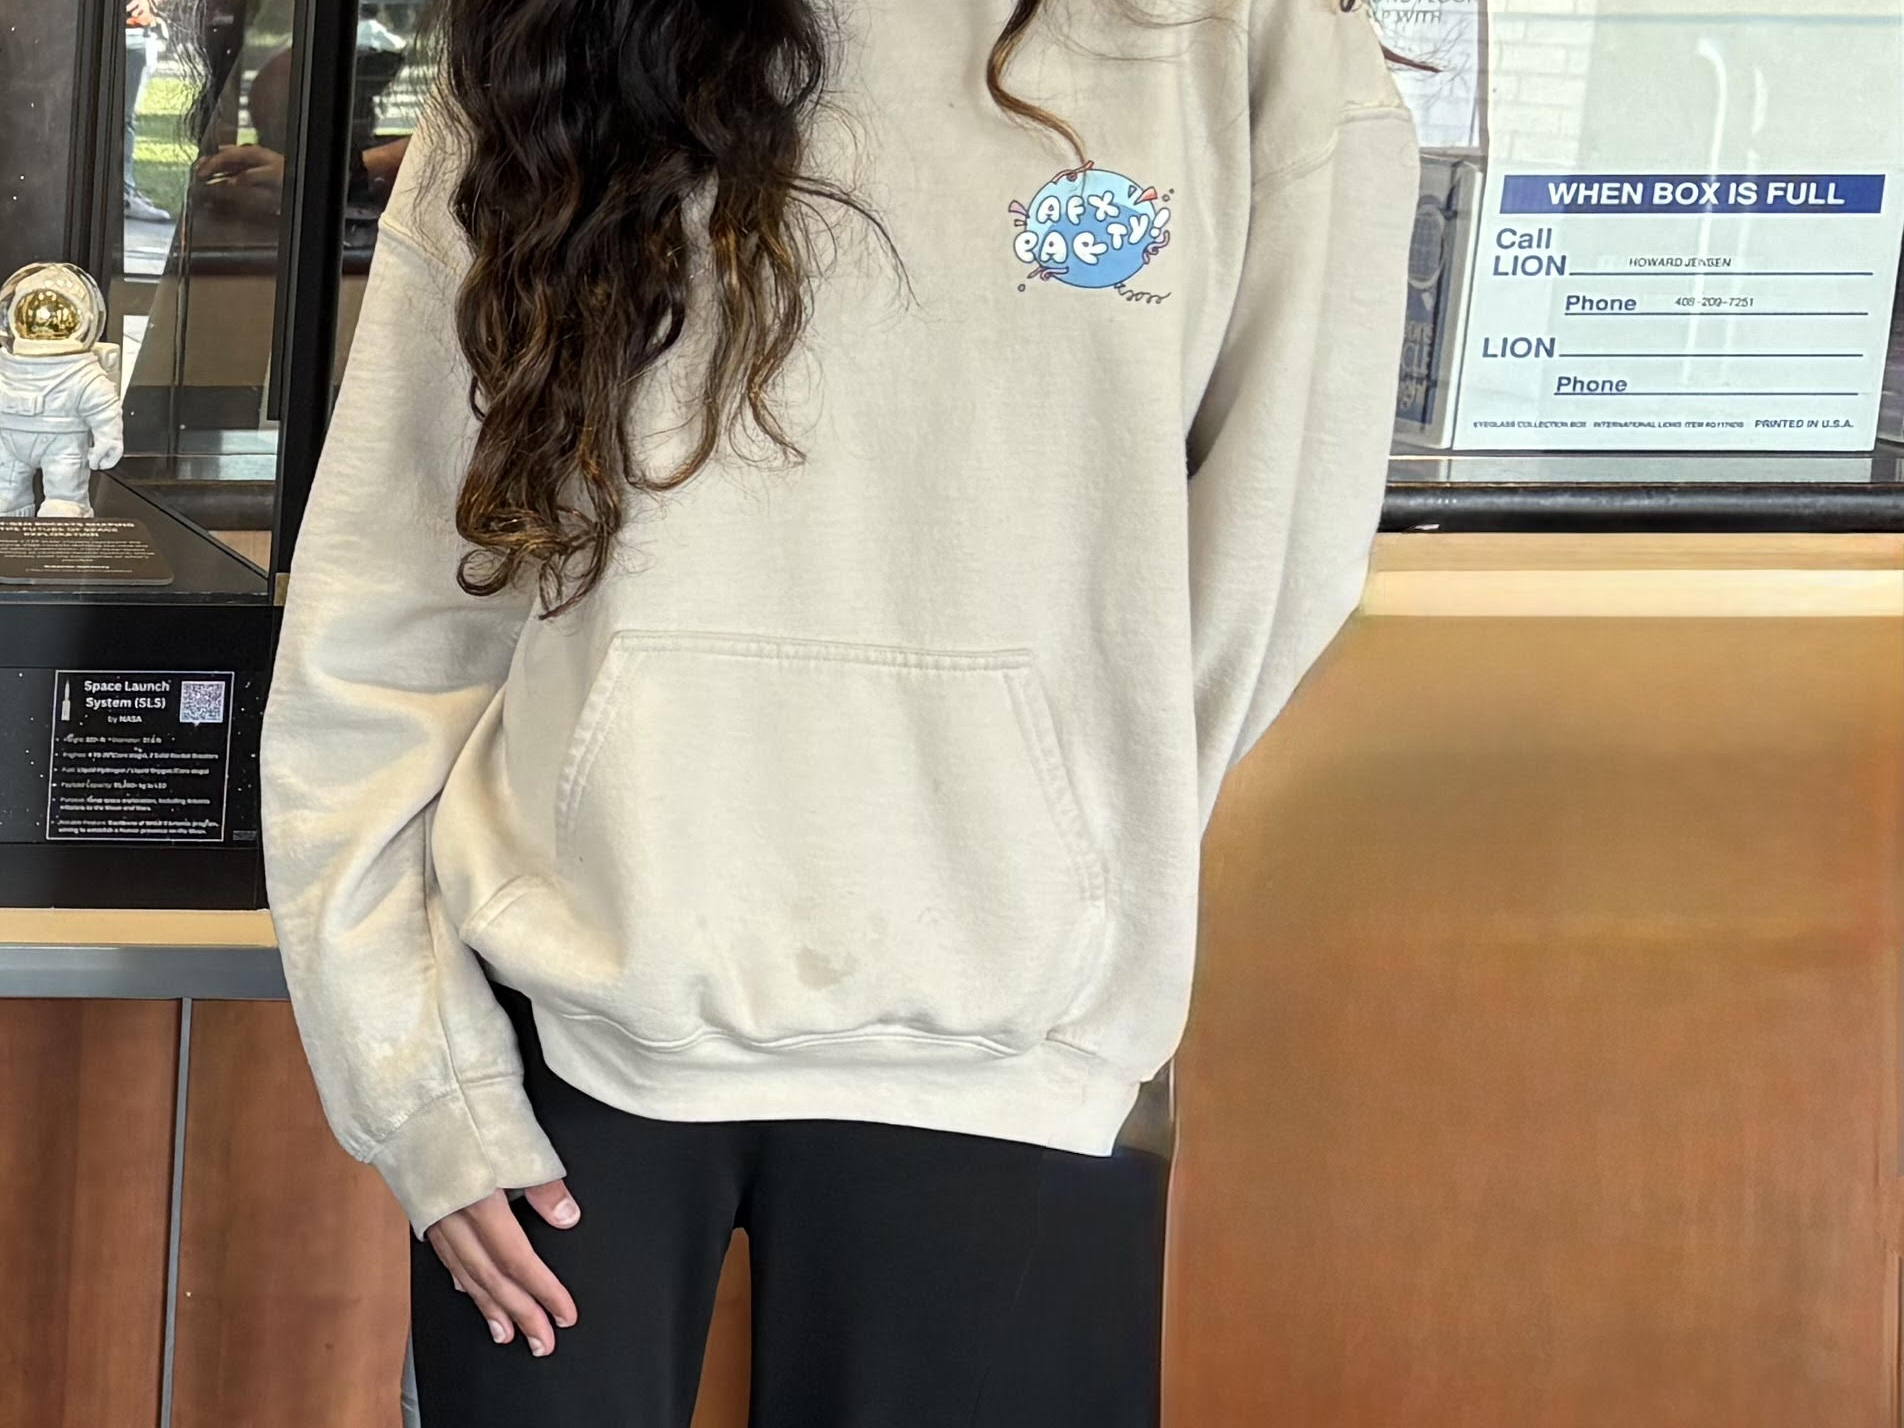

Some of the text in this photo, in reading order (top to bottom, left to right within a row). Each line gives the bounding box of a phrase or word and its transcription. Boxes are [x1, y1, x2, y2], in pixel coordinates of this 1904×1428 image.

[1548, 182, 1845, 206] WHEN BOX IS FULL
[1036, 191, 1119, 225] AFX
[1013, 208, 1171, 265] PARTY!
[1496, 227, 1552, 250] Call
[1492, 255, 1567, 277] LION
[1565, 294, 1637, 312] Phone
[1482, 337, 1557, 359] LION
[1556, 376, 1628, 393] Phone
[1754, 419, 1803, 429] PRINTED
[1807, 419, 1819, 429] IN
[84, 681, 170, 695] Space Launch
[85, 696, 166, 711] System (SLS)
[119, 715, 142, 723] NASA
